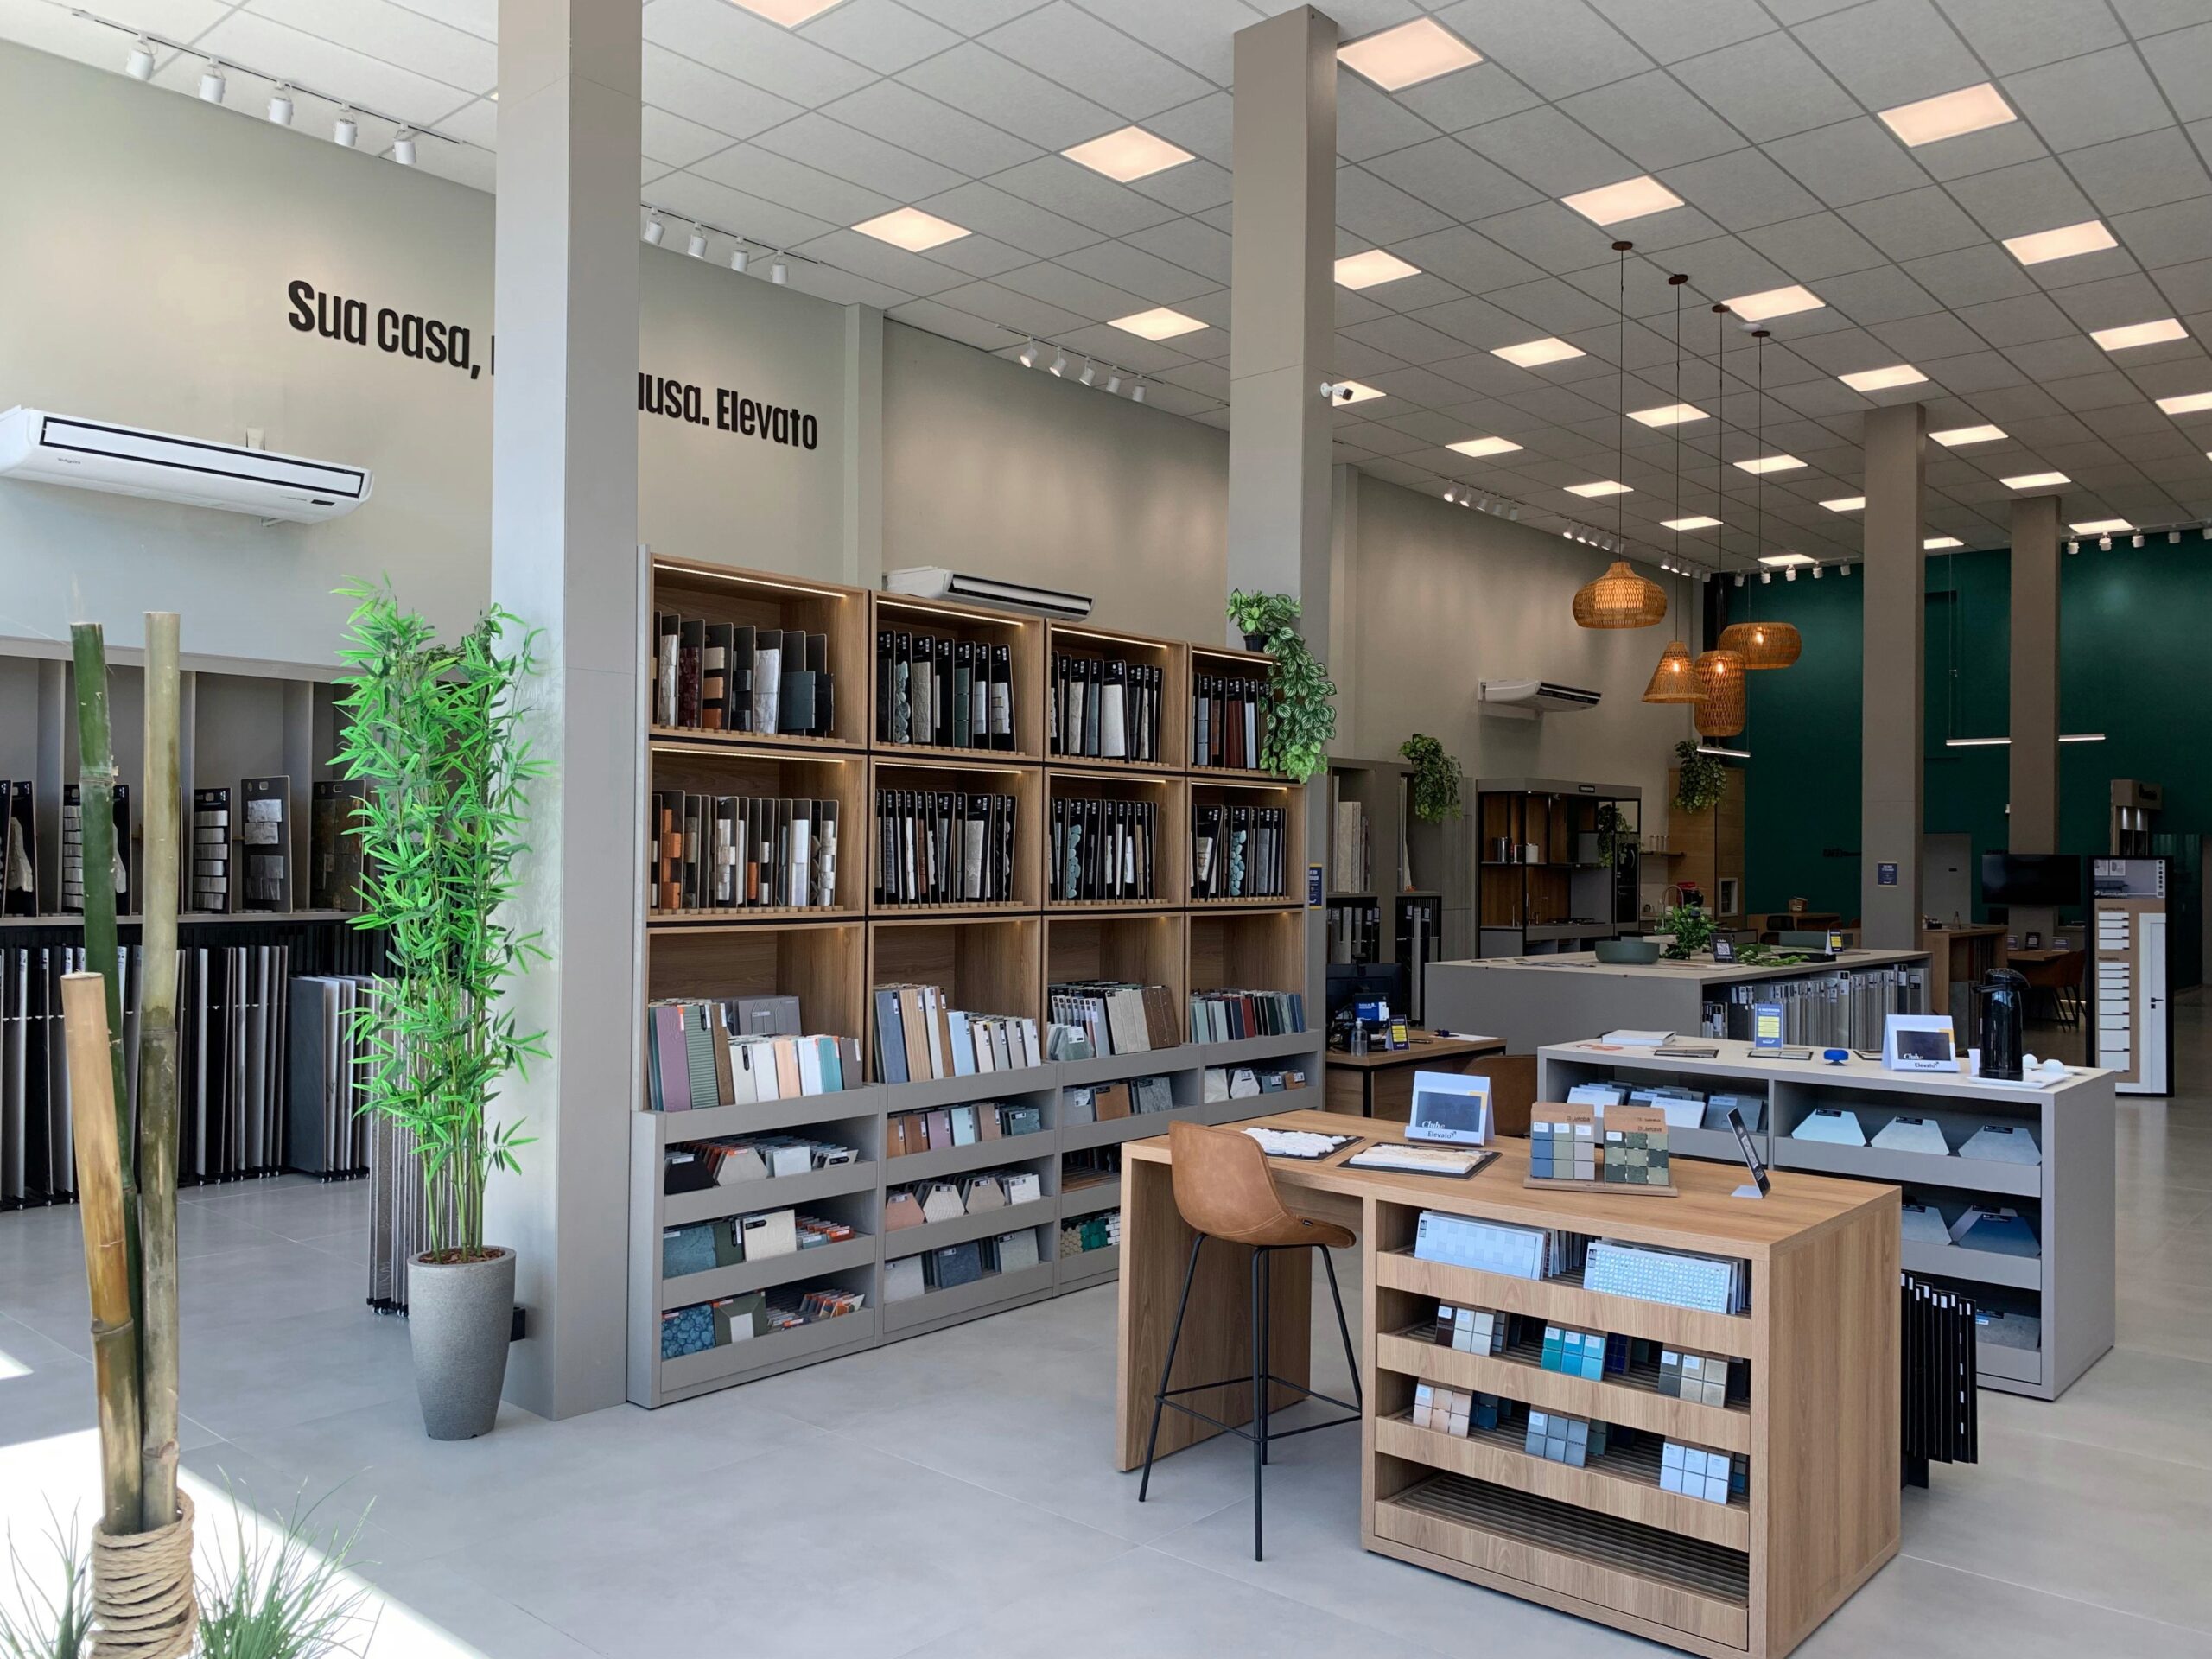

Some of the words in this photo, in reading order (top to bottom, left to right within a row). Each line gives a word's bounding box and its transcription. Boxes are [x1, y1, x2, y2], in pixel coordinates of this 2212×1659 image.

[288, 279, 367, 346] Sua
[376, 307, 481, 380] casa,
[716, 387, 818, 450] Elevato
[1427, 1130, 1452, 1140] Elevato
